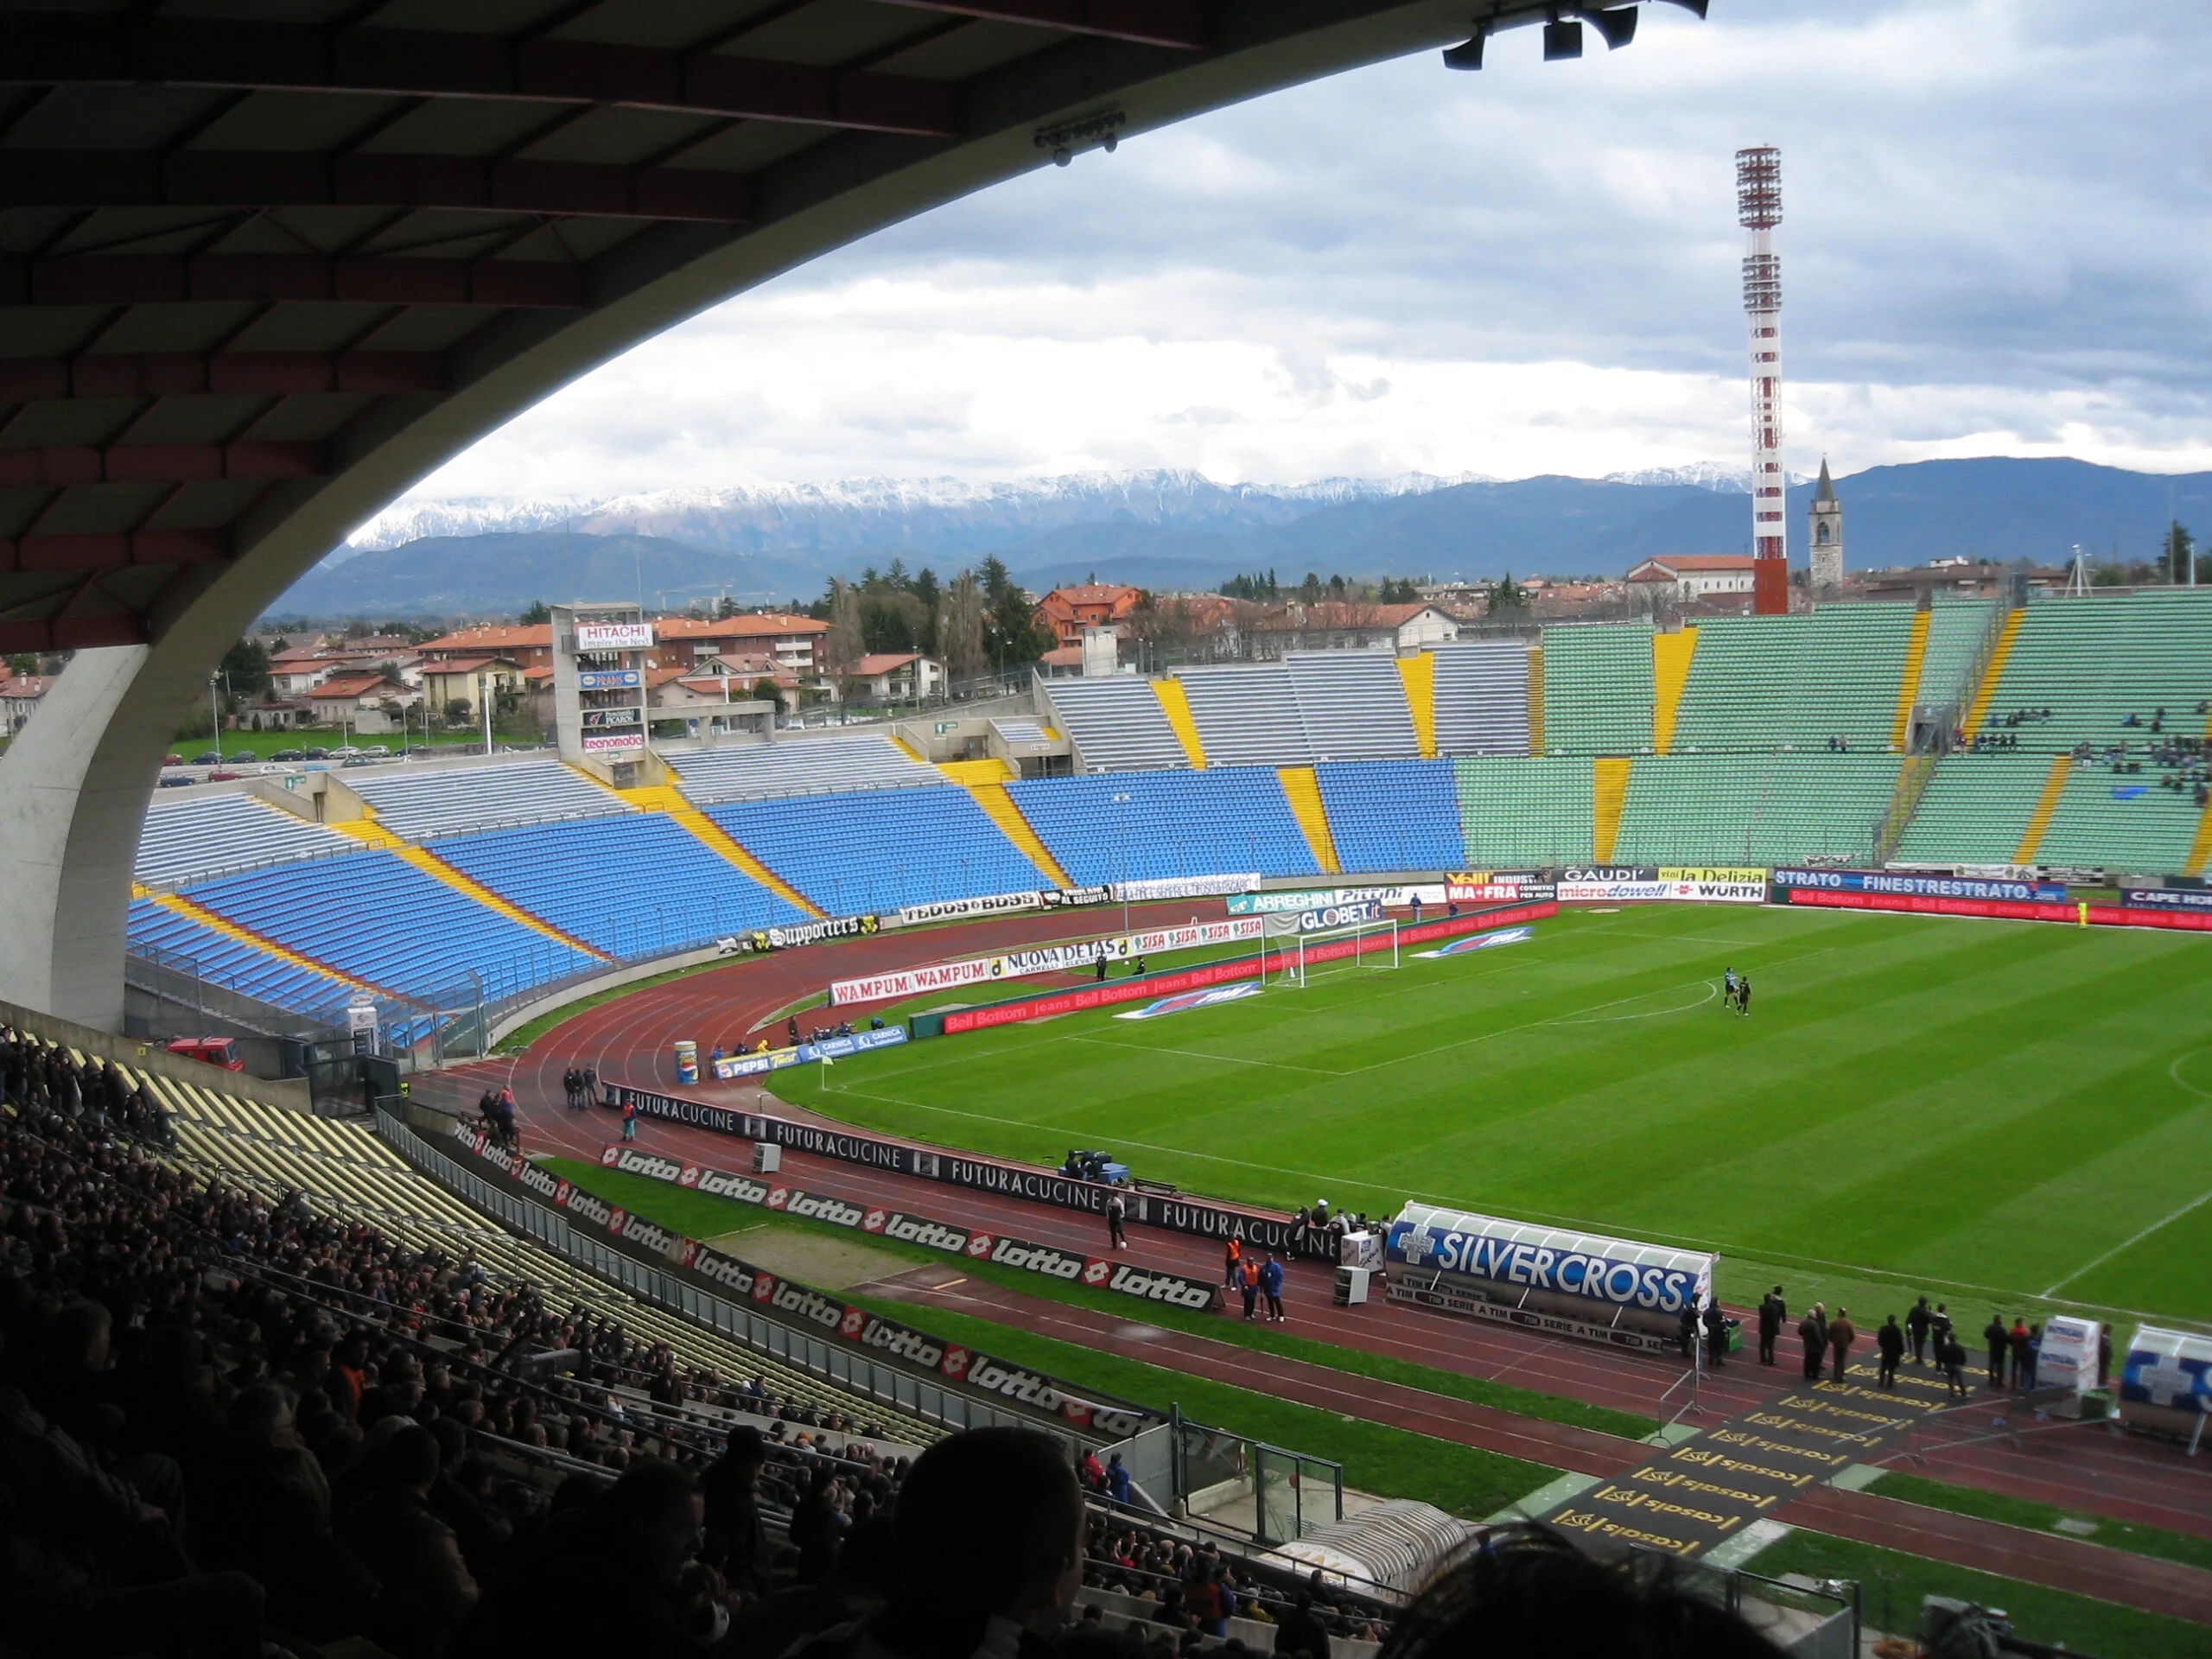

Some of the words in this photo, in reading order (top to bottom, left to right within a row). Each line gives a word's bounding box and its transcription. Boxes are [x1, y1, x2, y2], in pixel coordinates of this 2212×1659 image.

[583, 639, 611, 648] Inspire
[615, 638, 629, 646] the
[630, 637, 649, 646] Next
[588, 626, 645, 639] HITACHI
[584, 734, 643, 749] tecnomatic
[1681, 868, 1695, 882] la
[1702, 868, 1763, 883] Delizia
[1776, 870, 1841, 887] STRATO
[1061, 895, 1072, 905] AL
[1073, 893, 1109, 905] SEGUITO
[1254, 892, 1334, 912] ARREGHINI
[1559, 883, 1668, 898] microdowell
[1699, 883, 1763, 898] WÜRTH
[1791, 890, 1815, 902] Bell
[1817, 893, 1864, 906] Bottom
[1911, 899, 1936, 911] Bell
[1938, 900, 1986, 913] Bottom
[2130, 891, 2180, 904] CAPE
[906, 901, 969, 921] TEDDY
[982, 891, 1035, 911] BOYS
[769, 915, 858, 946] Supporters
[1175, 929, 1198, 944] SISA
[1208, 925, 1230, 938] SISA
[1240, 920, 1262, 934] SISA
[1008, 948, 1059, 969] NUOVA
[1064, 938, 1115, 960] DETAS
[1141, 933, 1165, 949] SISA
[914, 962, 985, 988] WAMPUM
[950, 1014, 974, 1031] Bell
[976, 1005, 1027, 1026] Bottom
[1075, 991, 1099, 1007] Bell
[1102, 982, 1147, 1002] Bottom
[1192, 970, 1212, 985] Bell
[1215, 963, 1257, 981] Bottom
[1410, 925, 1445, 942] Bottom
[1019, 963, 1058, 975] CARRELLI
[835, 976, 908, 1002] WAMPUM
[734, 1058, 769, 1074] PEPSI
[771, 1052, 798, 1069] Twist
[629, 1091, 734, 1132] FUTURACUCINE
[481, 1139, 512, 1172] lotto
[777, 1124, 900, 1167] FUTURACUCINE
[617, 1149, 681, 1181] lotto
[520, 1161, 558, 1198] lotto
[697, 1169, 767, 1204] lotto
[952, 1160, 1101, 1211] FUTURACUCINE
[567, 1188, 609, 1226] lotto
[787, 1190, 863, 1227] lotto
[885, 1214, 967, 1252] lotto
[694, 1249, 753, 1294] lotto
[991, 1238, 1083, 1281] lotto
[1109, 1266, 1211, 1310] lotto
[772, 1281, 842, 1328] lotto
[1395, 1287, 1413, 1299] TIM
[1447, 1299, 1474, 1312] SERIE
[1478, 1306, 1486, 1315] A
[1490, 1307, 1508, 1319] TIM
[1543, 1319, 1573, 1332] SERIE
[1577, 1325, 1586, 1334] A
[1588, 1327, 1608, 1340] TIM
[862, 1318, 943, 1368] lotto
[1791, 1421, 1867, 1442] casals
[1757, 1440, 1832, 1461] casals
[1719, 1459, 1798, 1481] casals
[1682, 1478, 1761, 1503] casals
[1644, 1499, 1724, 1524] casals
[1601, 1522, 1683, 1549] casals
